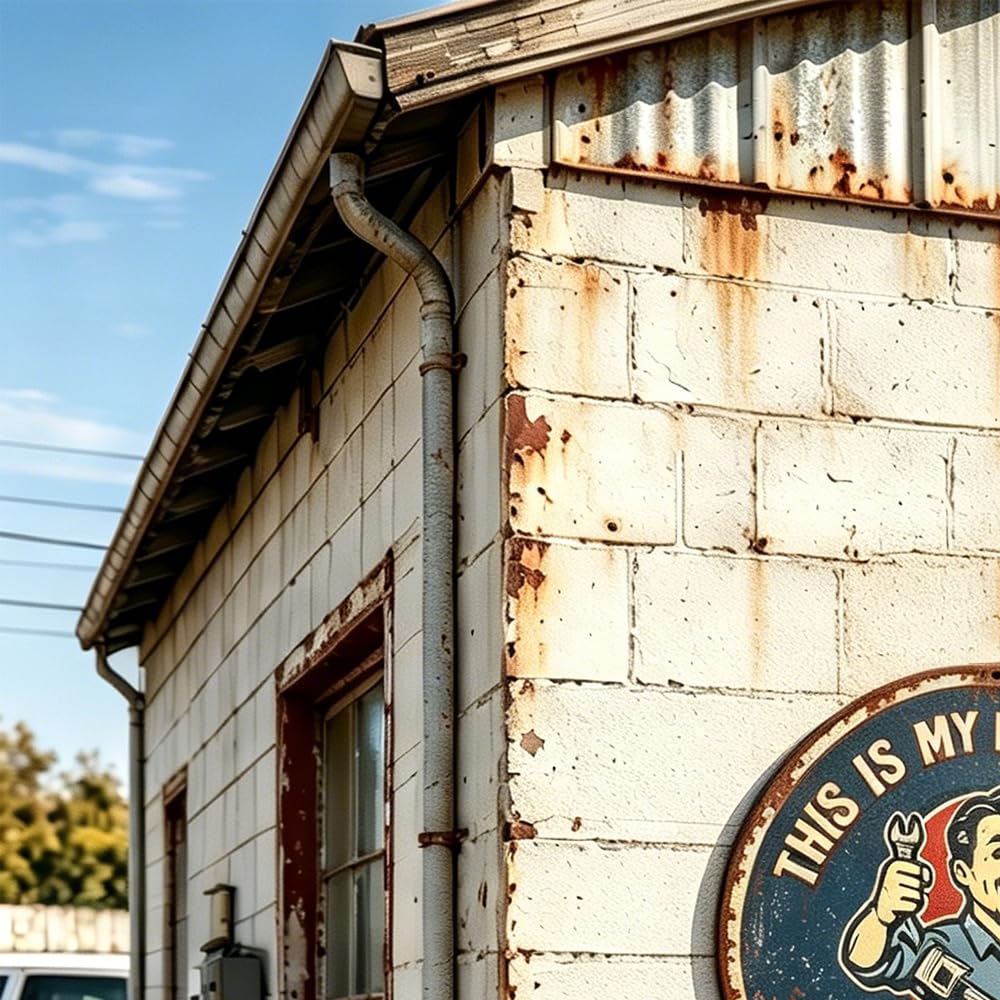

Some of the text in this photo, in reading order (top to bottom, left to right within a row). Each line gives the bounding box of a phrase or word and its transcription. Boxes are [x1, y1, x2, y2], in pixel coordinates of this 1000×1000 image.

[772, 781, 861, 887] THIS
[851, 738, 907, 798] IS
[912, 710, 980, 767] MY
